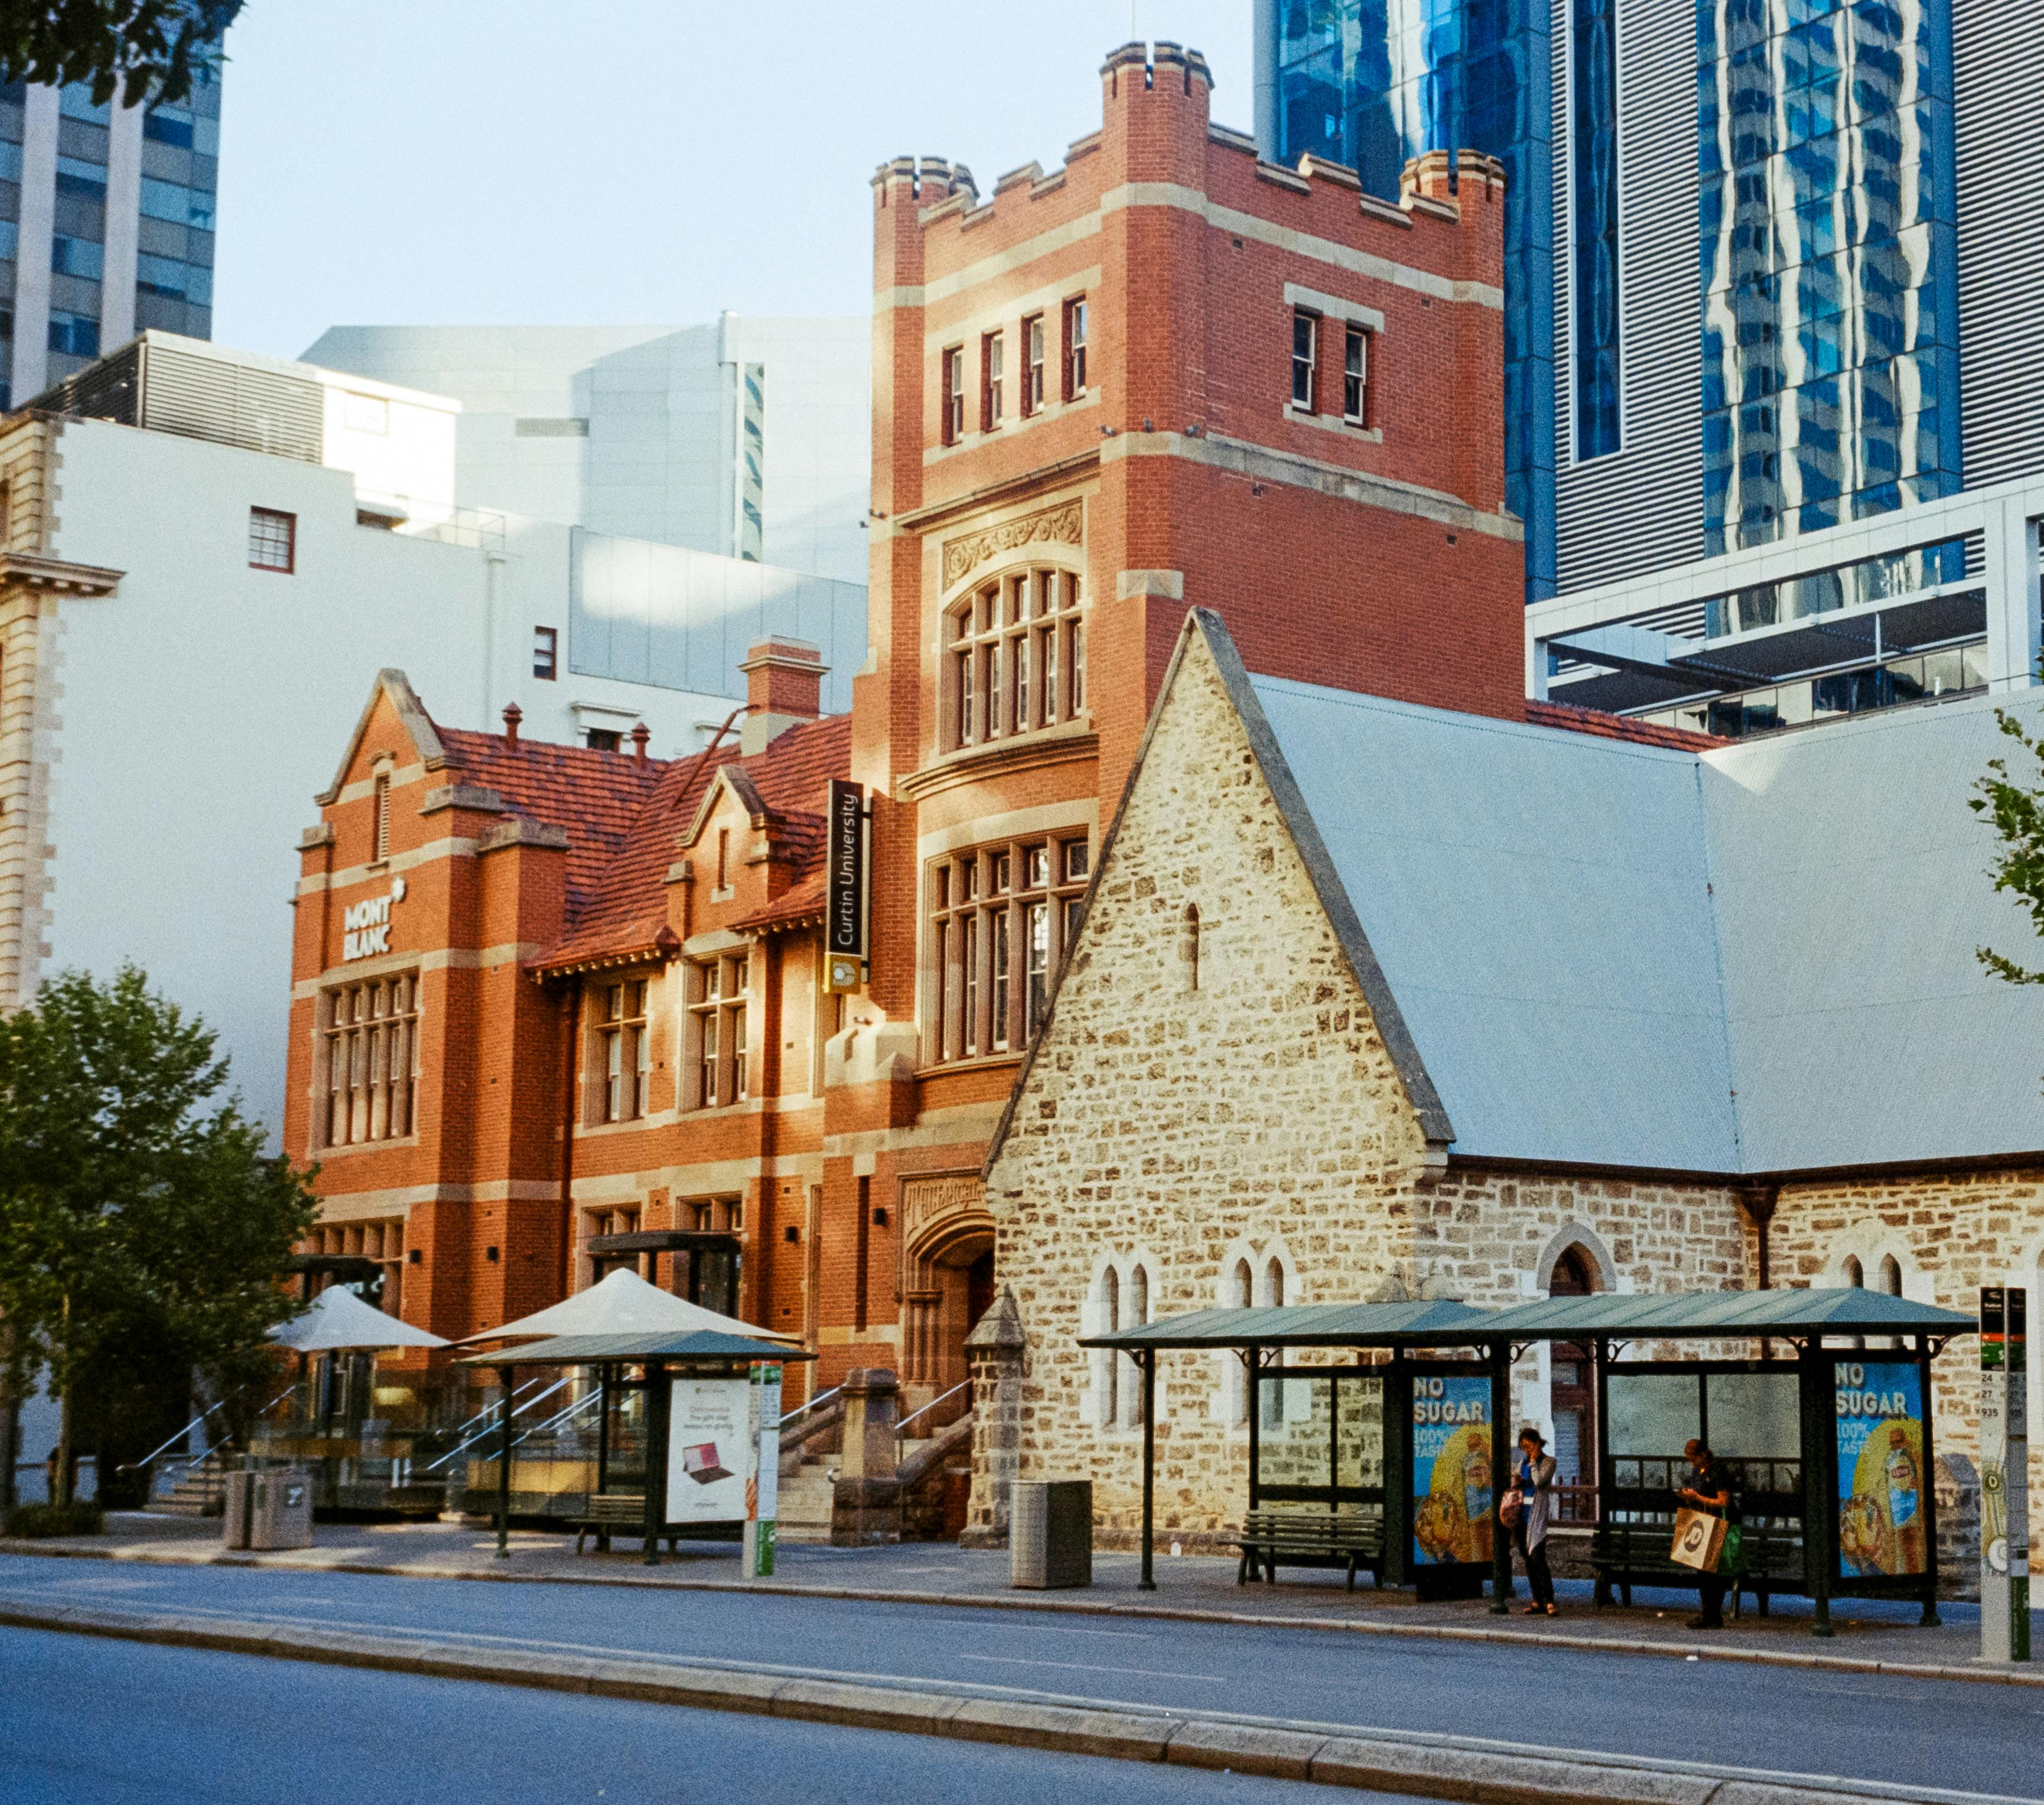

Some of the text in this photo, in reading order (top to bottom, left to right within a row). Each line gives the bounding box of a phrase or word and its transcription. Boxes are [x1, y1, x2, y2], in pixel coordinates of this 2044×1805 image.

[838, 794, 858, 945] Curtin University
[344, 895, 392, 932] MONT
[343, 924, 390, 961] BLANC
[1835, 1362, 1865, 1386] NO
[1981, 1374, 1993, 1383] 24
[1413, 1377, 1444, 1397] NO
[1413, 1400, 1484, 1422] SUGAR
[1836, 1391, 1908, 1415] SUGAR
[1981, 1408, 1998, 1417] 935
